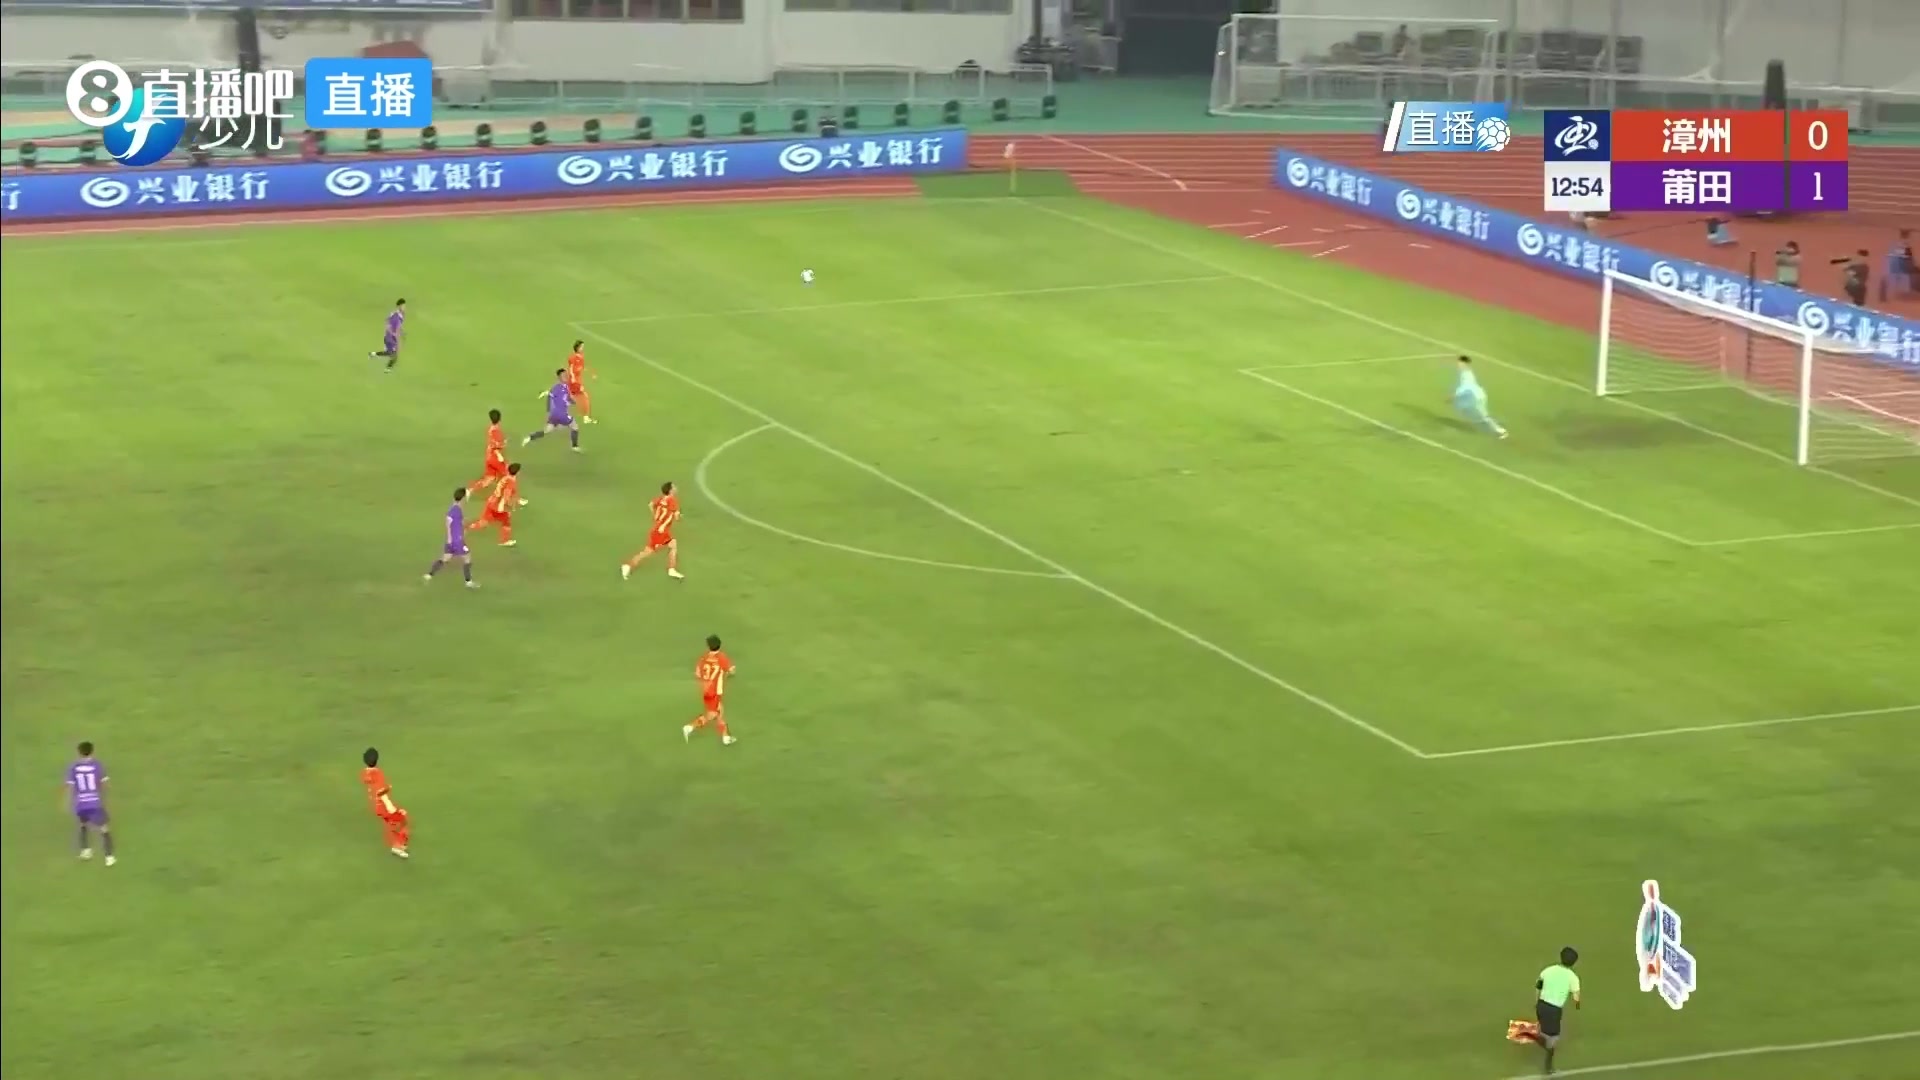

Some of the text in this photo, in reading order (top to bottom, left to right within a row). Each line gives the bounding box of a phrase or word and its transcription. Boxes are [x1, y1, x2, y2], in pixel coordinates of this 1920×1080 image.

[606, 149, 728, 182] 兴业银行
[826, 138, 943, 169] 兴业银行
[136, 171, 270, 204] 兴业银行
[378, 160, 503, 193] 兴业银行
[1310, 166, 1373, 206] 兴业银行
[1422, 198, 1490, 241] 兴业银行
[1544, 231, 1620, 273] 兴业银行
[75, 773, 96, 791] 11
